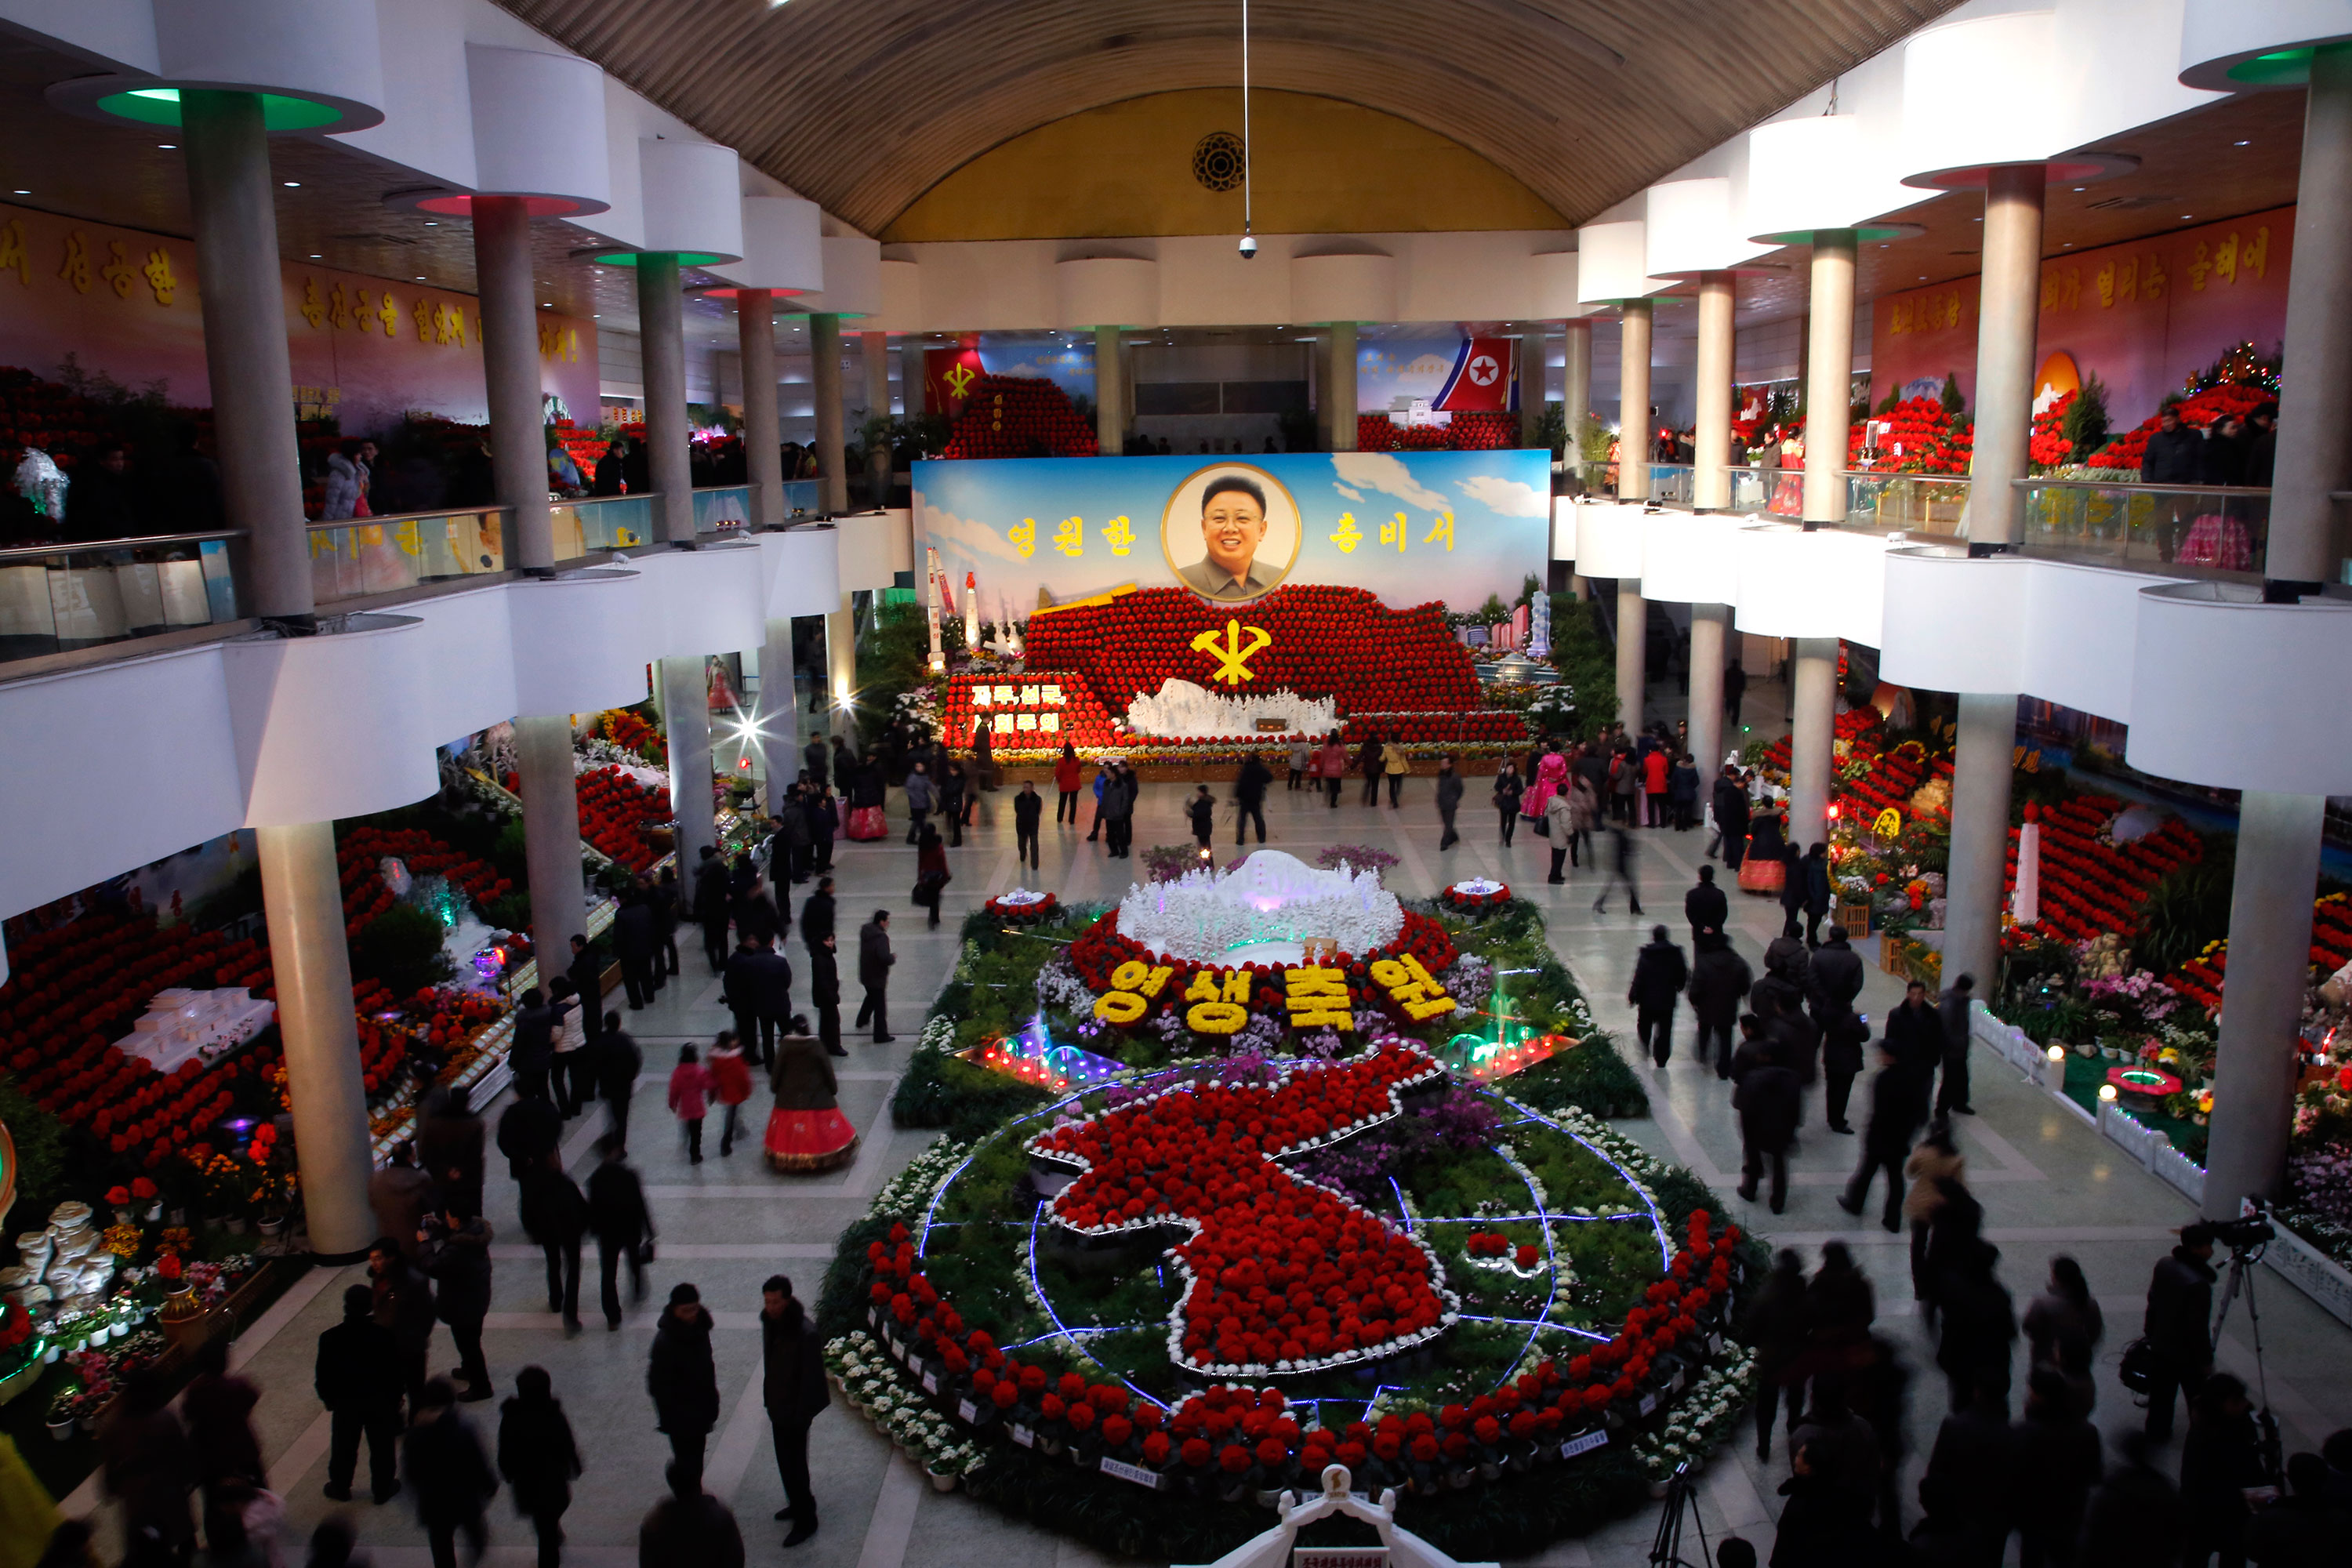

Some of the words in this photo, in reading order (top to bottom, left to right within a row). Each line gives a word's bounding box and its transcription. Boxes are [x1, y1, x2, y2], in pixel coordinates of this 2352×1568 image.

[1007, 515, 1137, 558] 영원한
[1329, 512, 1455, 554] 총비서
[1094, 953, 1457, 1036] 영생축원
